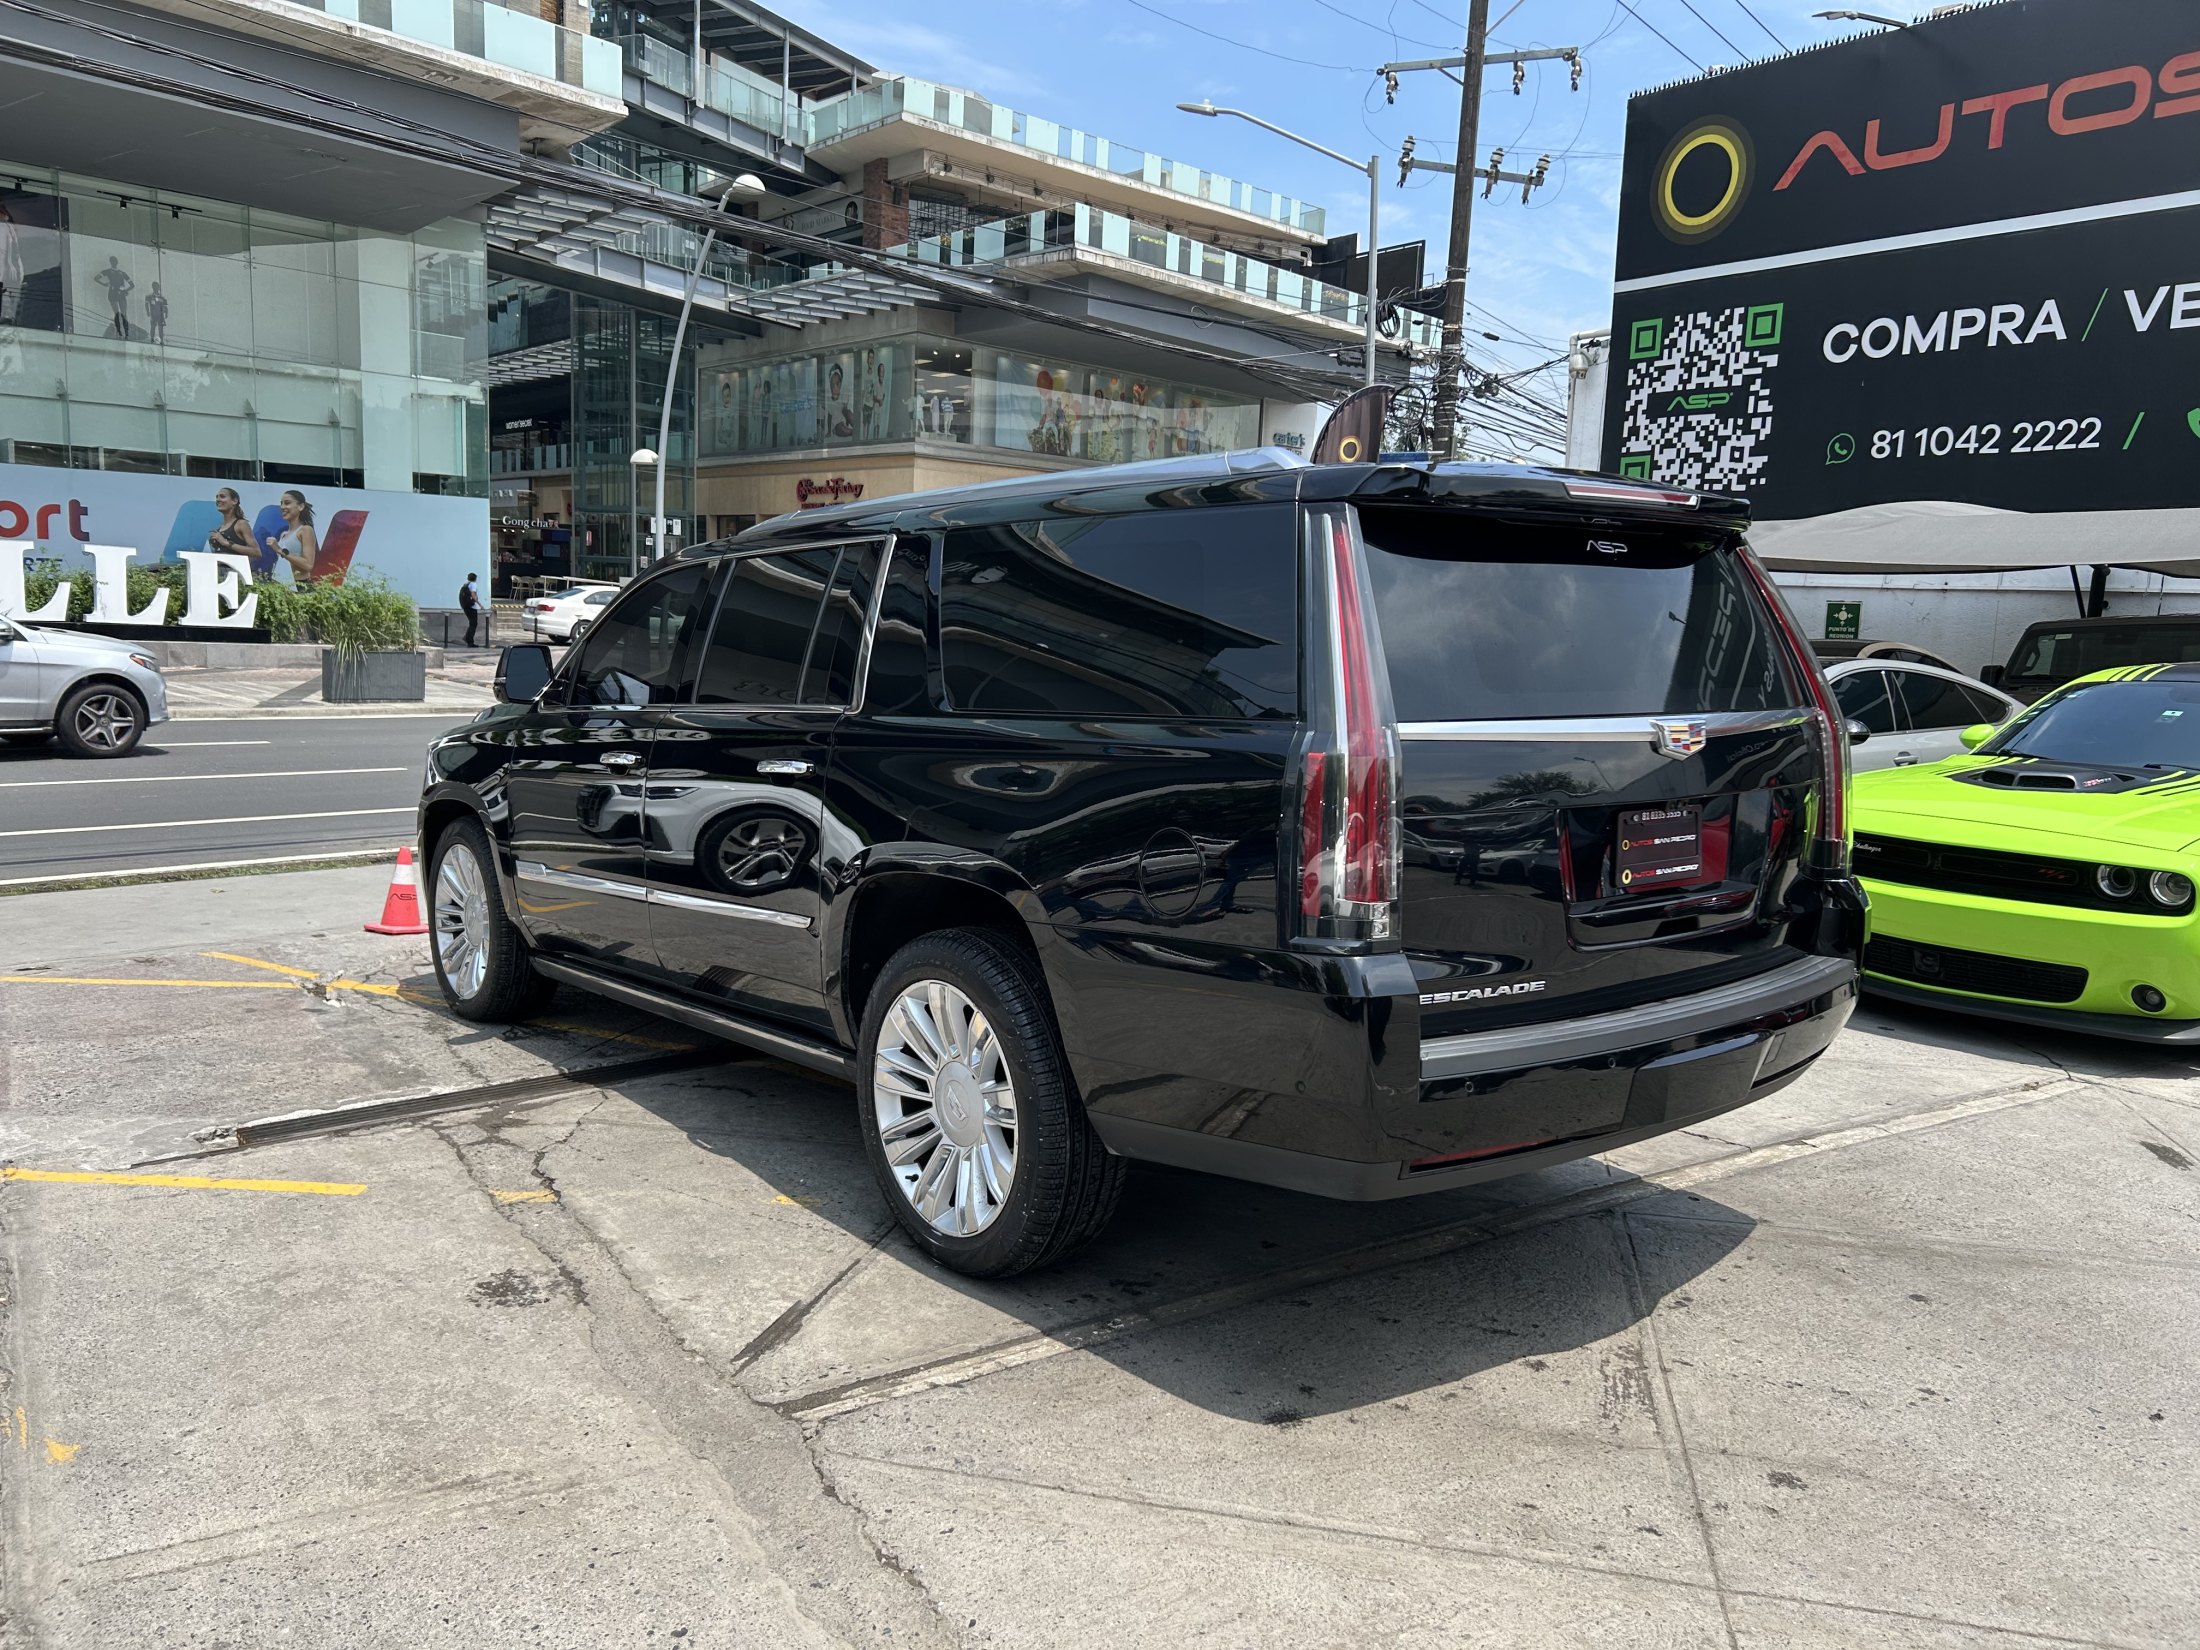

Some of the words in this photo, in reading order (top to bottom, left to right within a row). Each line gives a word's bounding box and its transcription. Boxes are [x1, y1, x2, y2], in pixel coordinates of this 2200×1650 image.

[1823, 299, 2068, 363] COMPRA
[1667, 392, 1730, 411] ASP
[1870, 430, 1905, 459] 81
[1914, 424, 2001, 457] 1042
[2010, 417, 2102, 453] 2222
[0, 499, 90, 541] ort
[502, 515, 530, 529] Gong
[531, 518, 549, 528] cha
[1586, 540, 1628, 554] ASP
[0, 539, 258, 628] LLE
[1418, 980, 1547, 1005] ESCALADE
